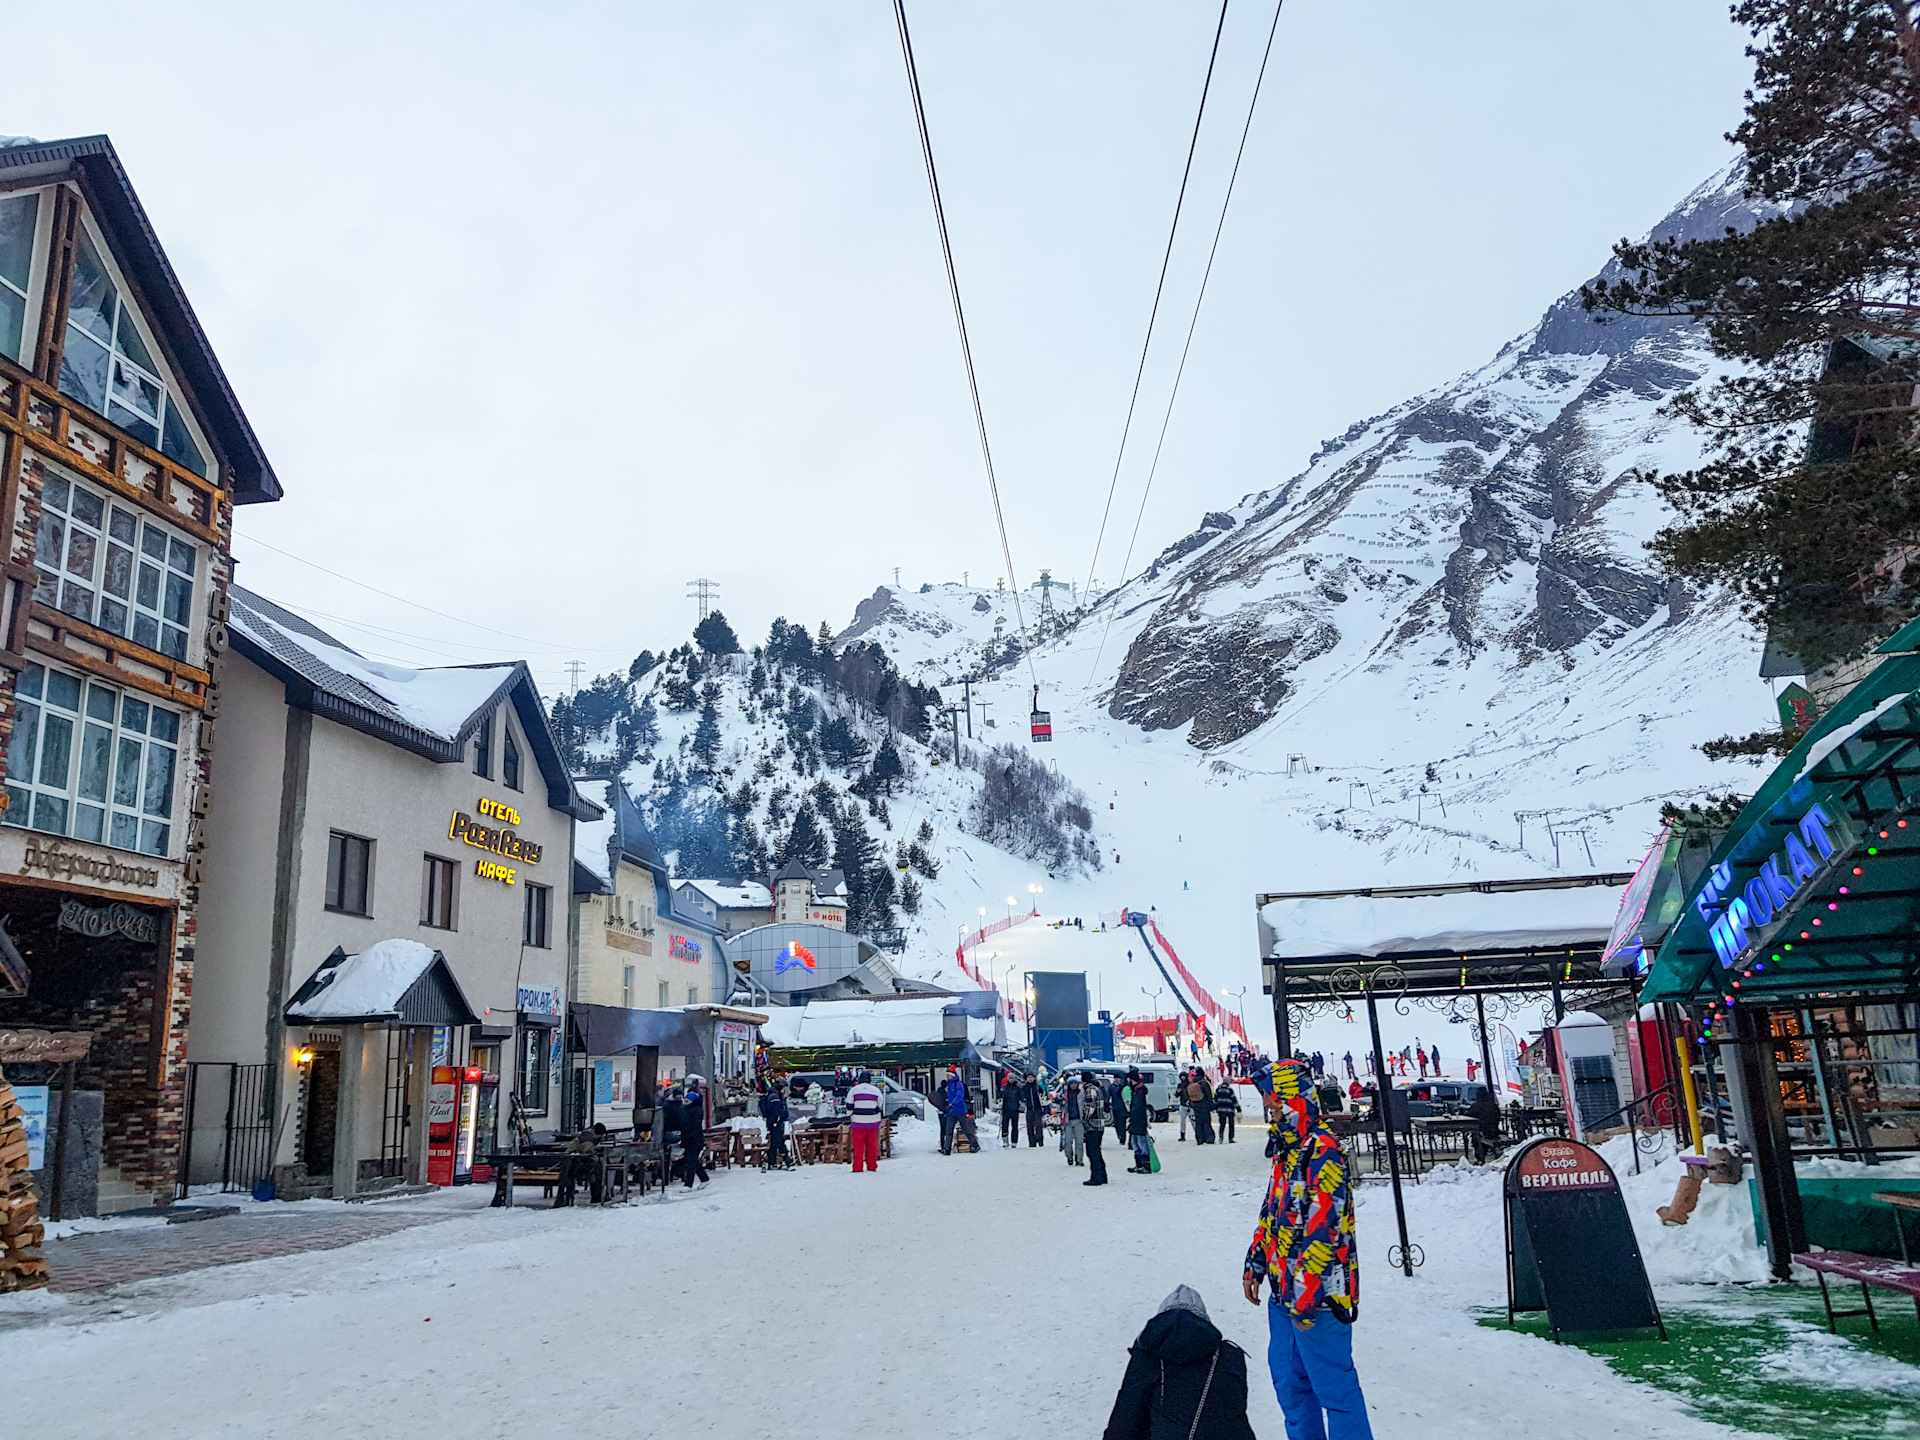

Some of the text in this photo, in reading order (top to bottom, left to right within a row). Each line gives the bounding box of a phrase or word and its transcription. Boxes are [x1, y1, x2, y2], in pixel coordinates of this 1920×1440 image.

[201, 590, 231, 752] HOTEL
[479, 798, 521, 825] ОТЕЛЬ
[190, 785, 214, 882] BAR
[477, 860, 517, 885] КАФЕ
[1709, 802, 1834, 969] ПРОКАТ
[821, 914, 843, 922] HOTEL
[516, 988, 551, 1009] ПРОКАТ
[429, 1105, 452, 1116] Bud
[1541, 1147, 1575, 1157] Отель
[1543, 1158, 1578, 1169] Кафе
[1522, 1170, 1610, 1188] ВЕРТИКАЛЬ
